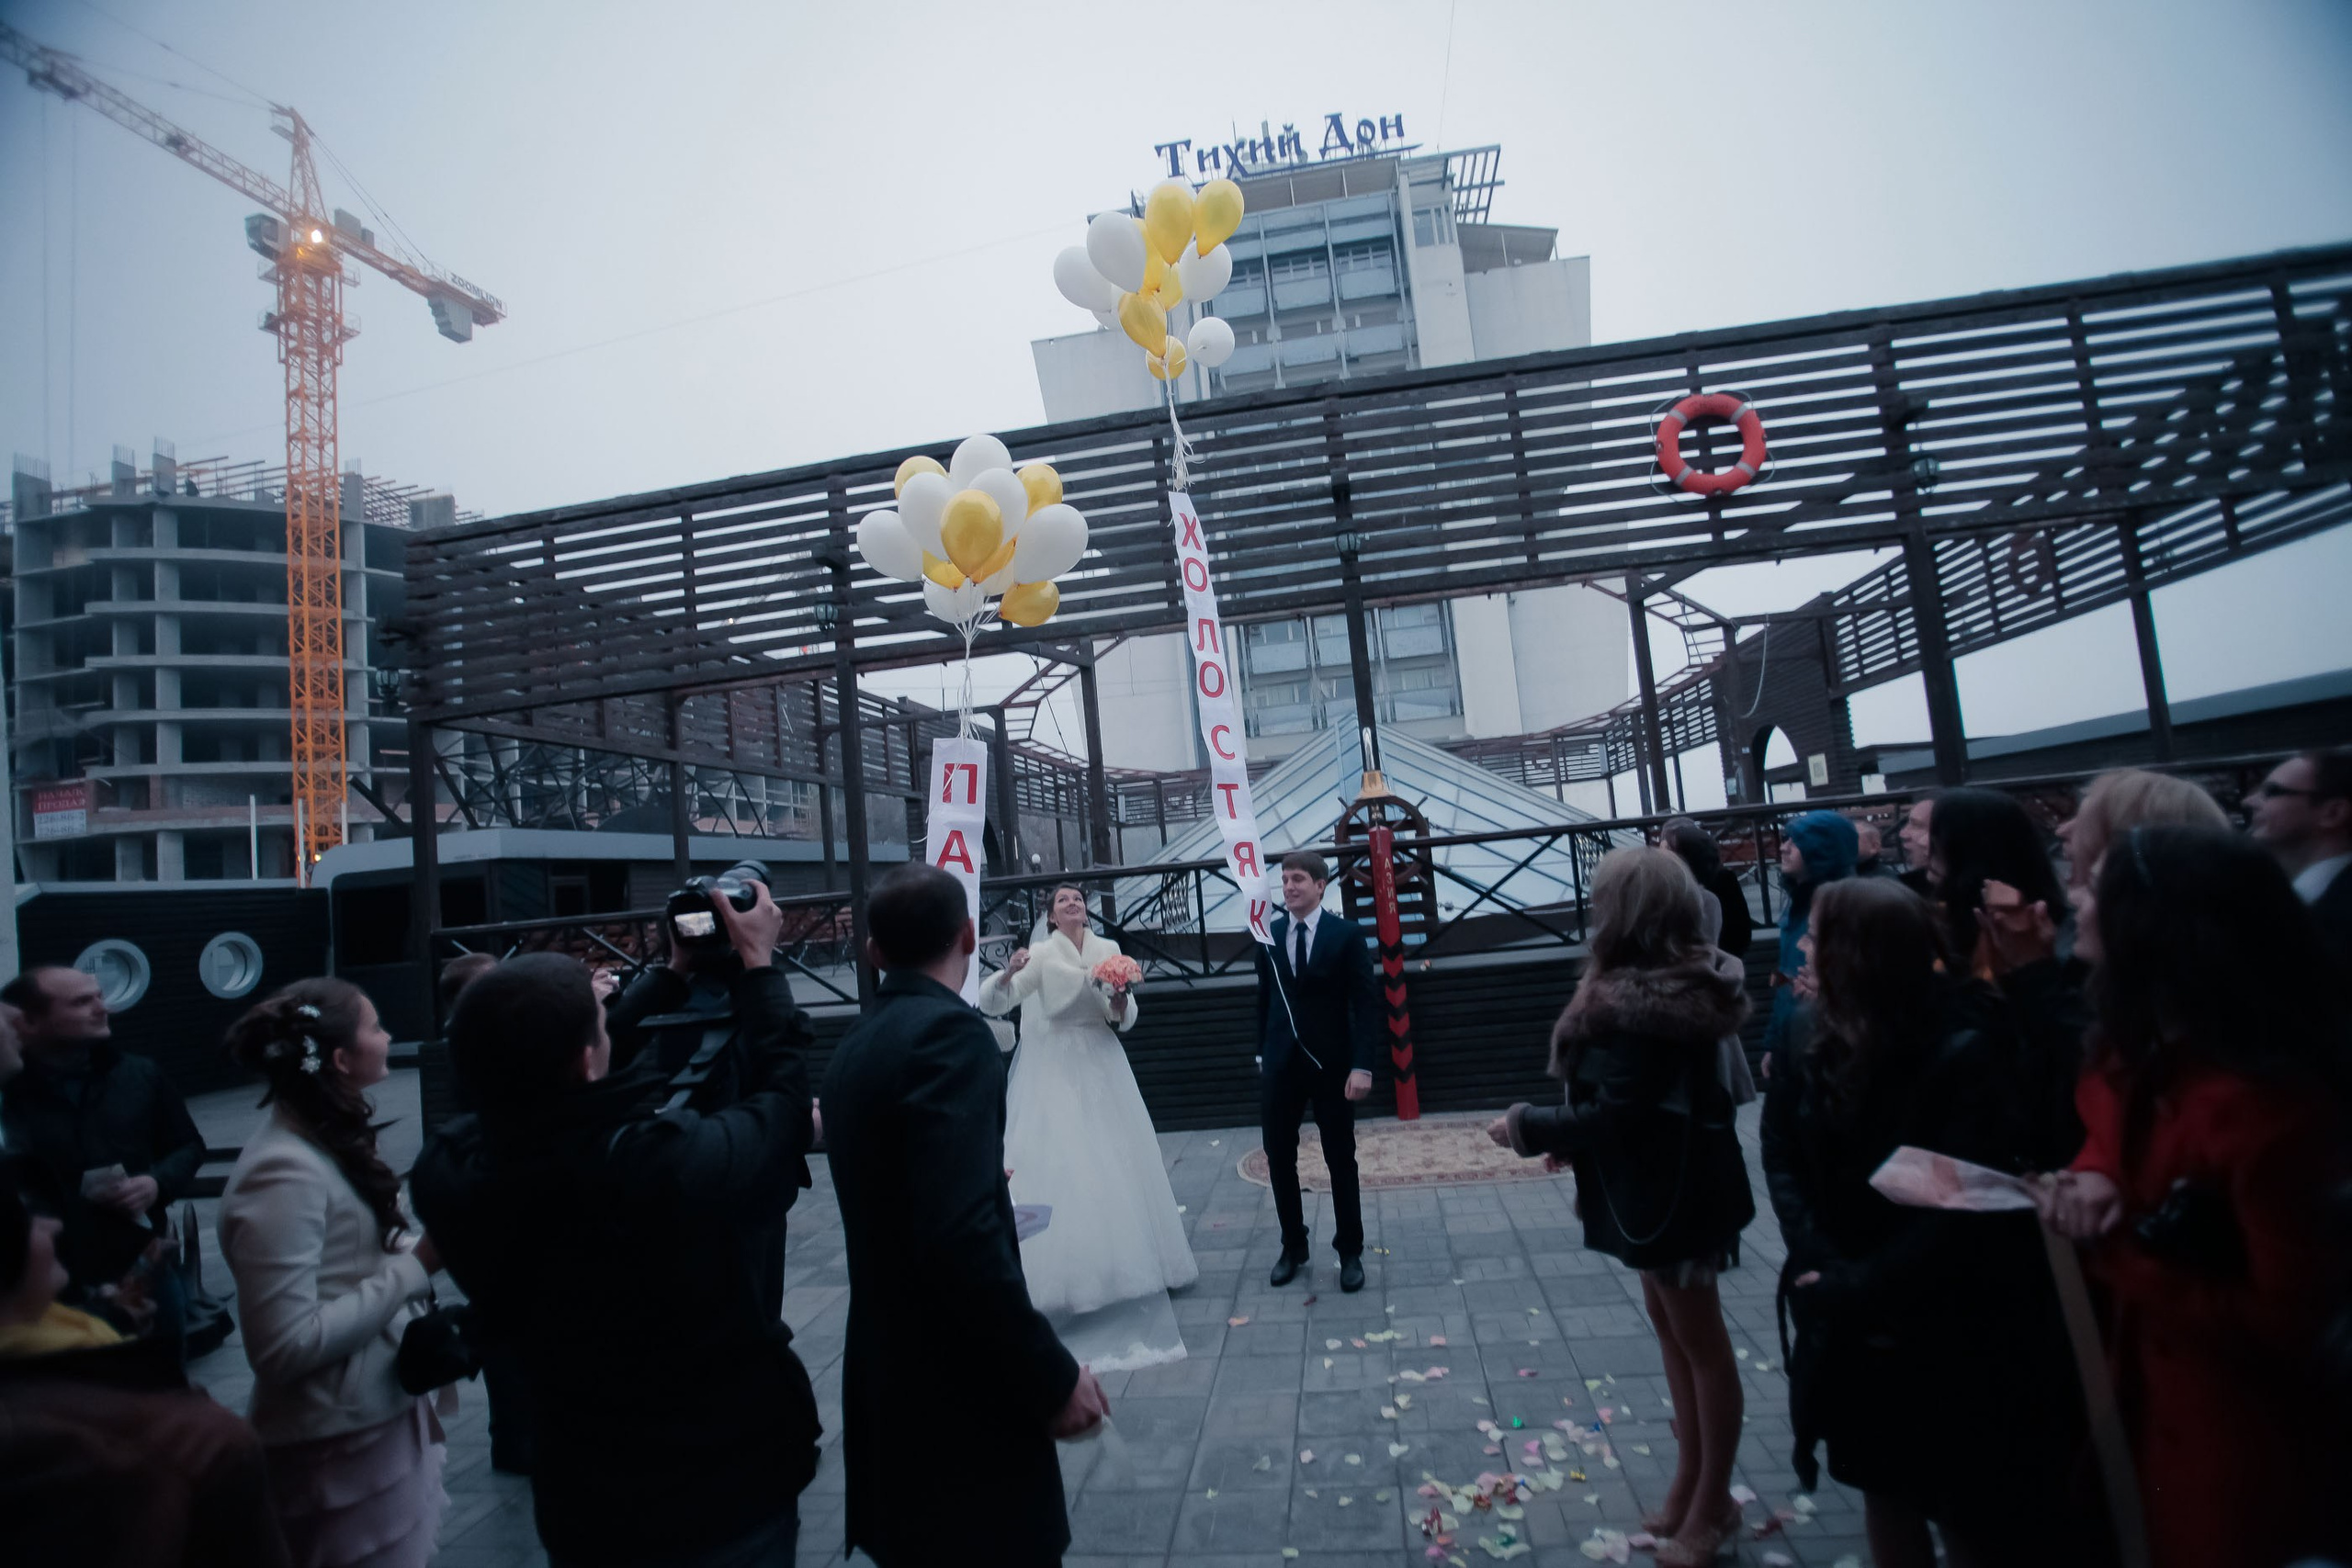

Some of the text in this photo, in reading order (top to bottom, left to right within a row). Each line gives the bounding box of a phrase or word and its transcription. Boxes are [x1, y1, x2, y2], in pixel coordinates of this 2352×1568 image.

[1319, 112, 1404, 159] Дон
[450, 272, 503, 310] ZOOMLION
[1181, 512, 1269, 939] ХОЛОСТЯК
[1384, 857, 1396, 914] АЗИЯ
